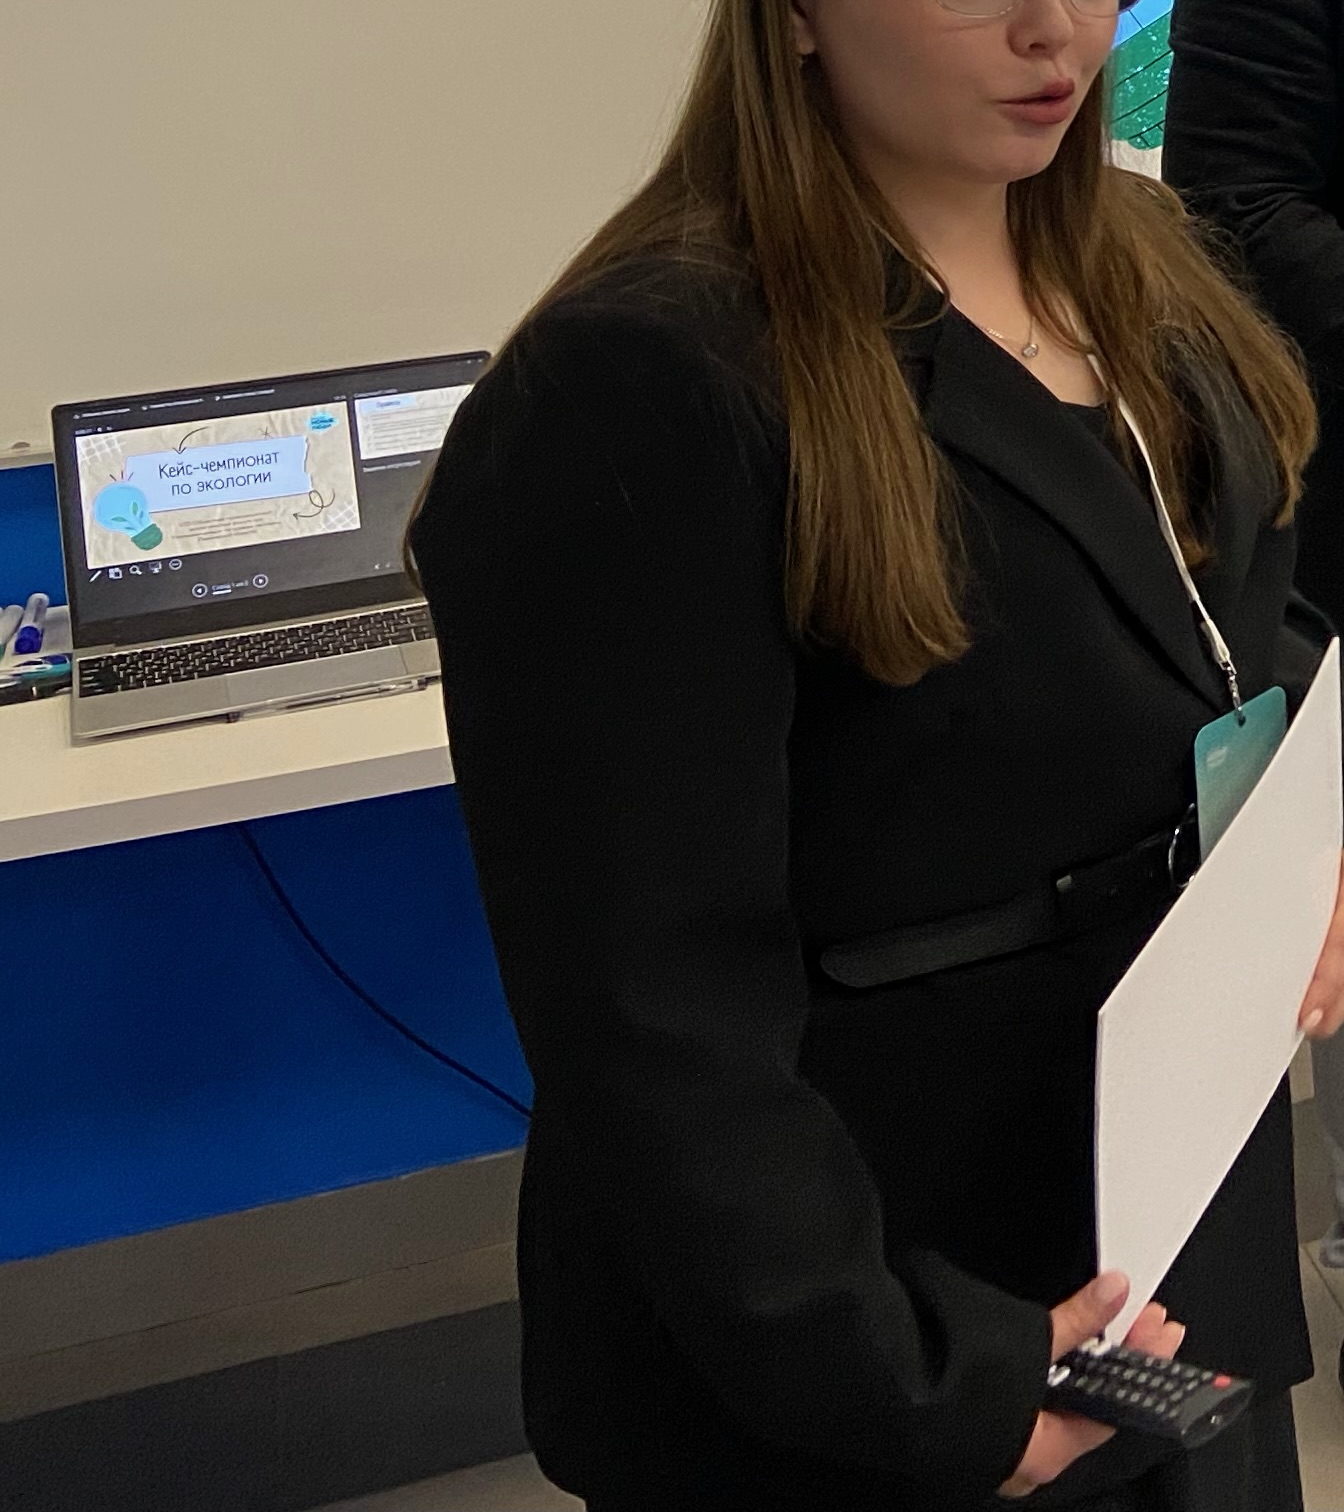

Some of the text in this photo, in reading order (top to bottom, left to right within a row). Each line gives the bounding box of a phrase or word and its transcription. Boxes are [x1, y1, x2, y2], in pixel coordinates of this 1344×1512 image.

[158, 451, 280, 480] Кейс-чемпионат
[171, 471, 272, 496] по экологии
